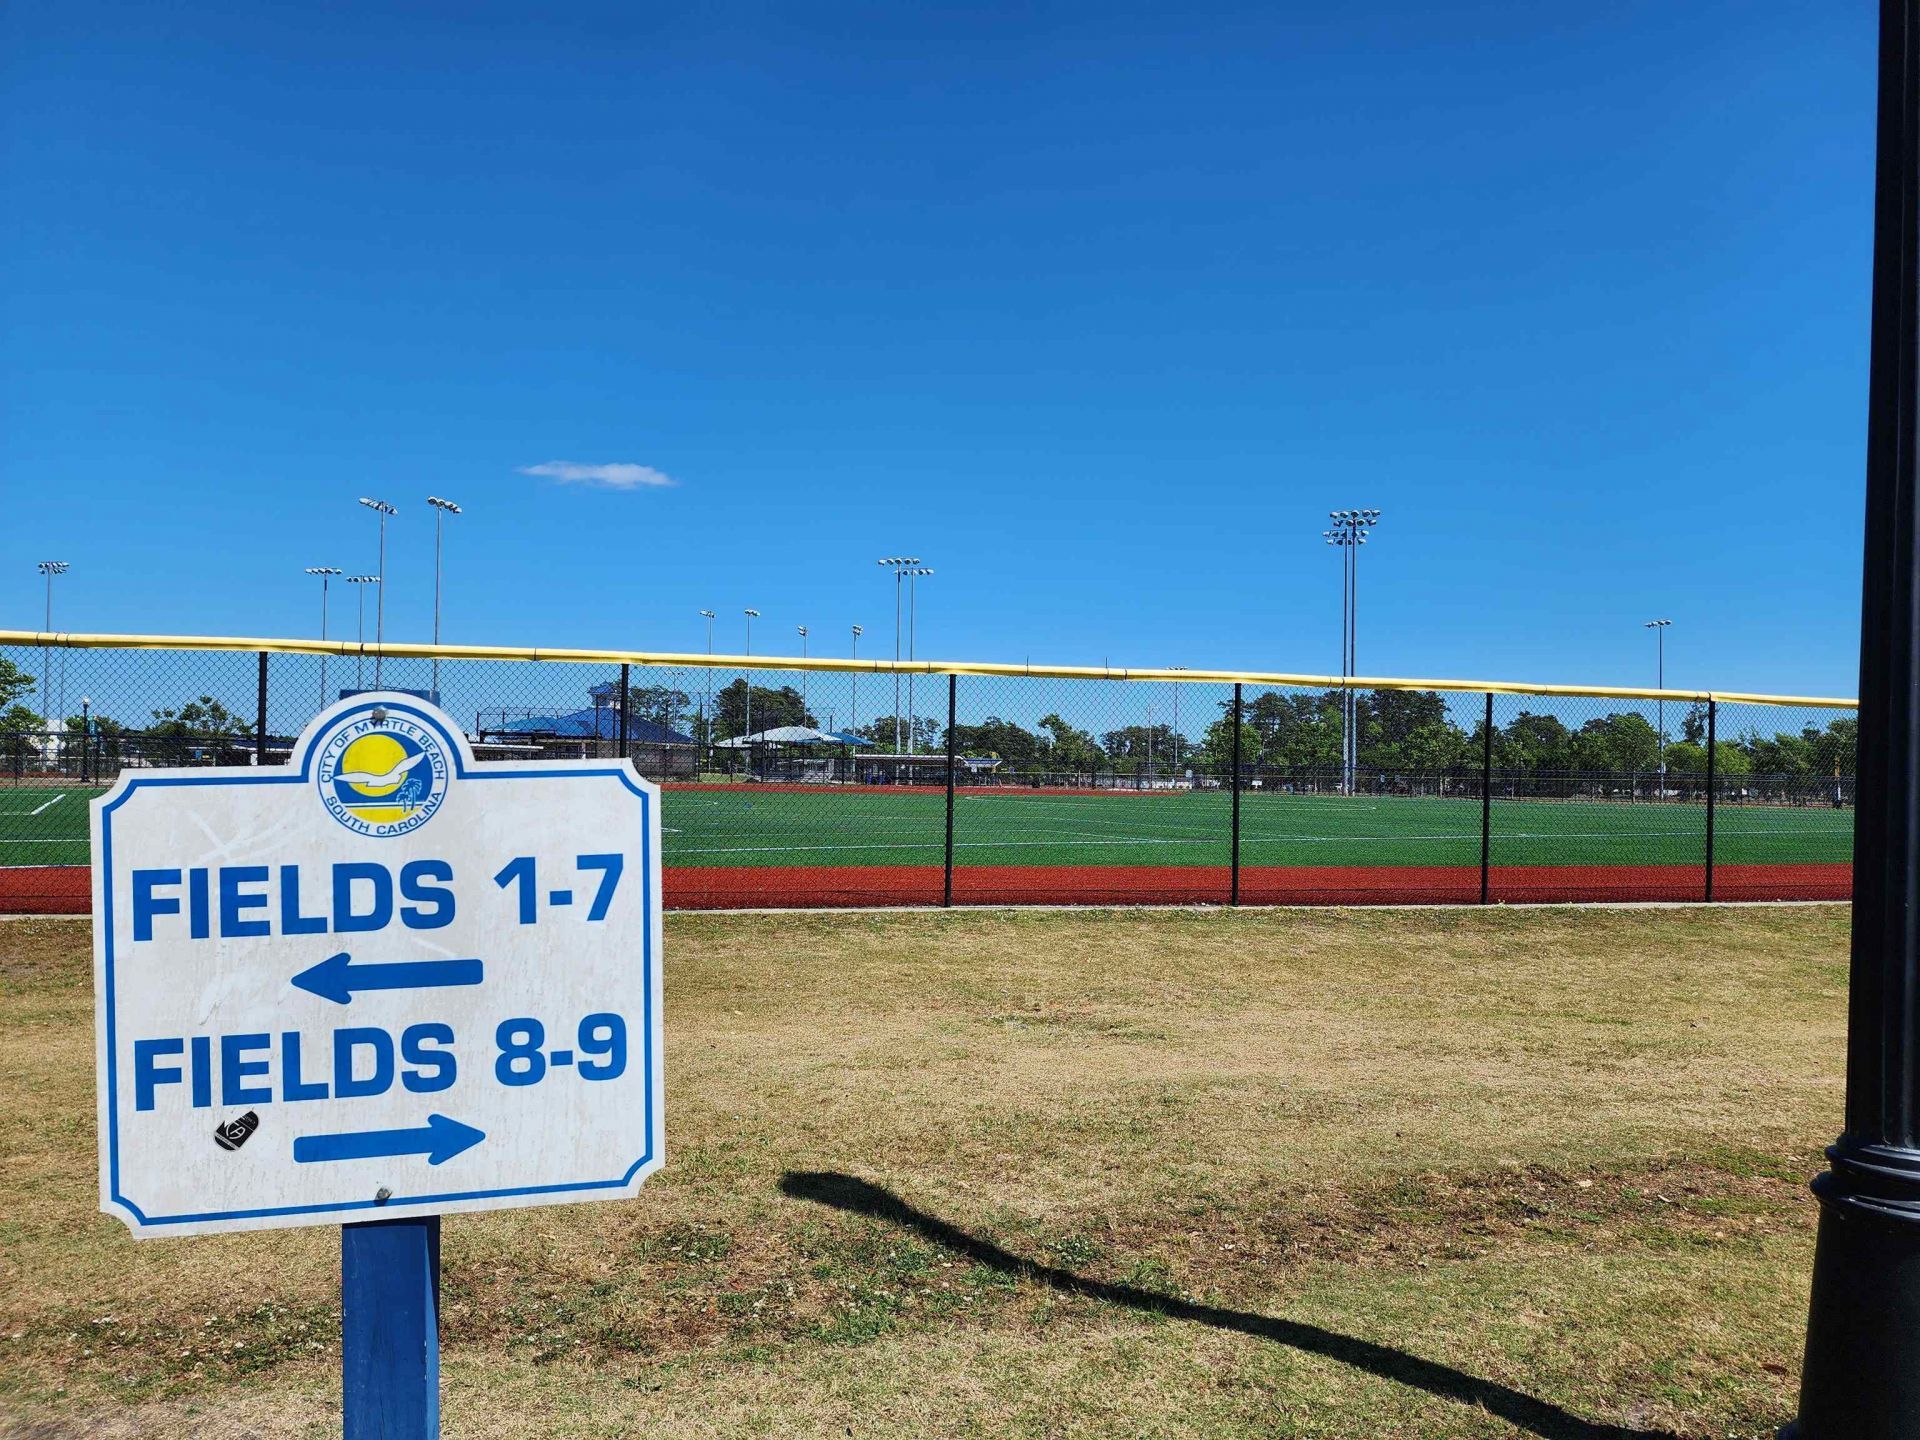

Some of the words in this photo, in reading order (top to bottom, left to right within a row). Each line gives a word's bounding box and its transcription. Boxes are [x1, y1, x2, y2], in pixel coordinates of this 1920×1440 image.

[321, 751, 336, 783] CITY
[334, 731, 351, 748] OF
[355, 720, 416, 737] MYRTLE
[419, 735, 445, 780] BEACH
[326, 795, 370, 833] SOUTH
[376, 792, 442, 835] CAROLINA
[132, 860, 455, 941] FIELDS
[494, 854, 624, 925] 1-7
[135, 1022, 457, 1111] FIELDS
[495, 1012, 628, 1087] 8-9
